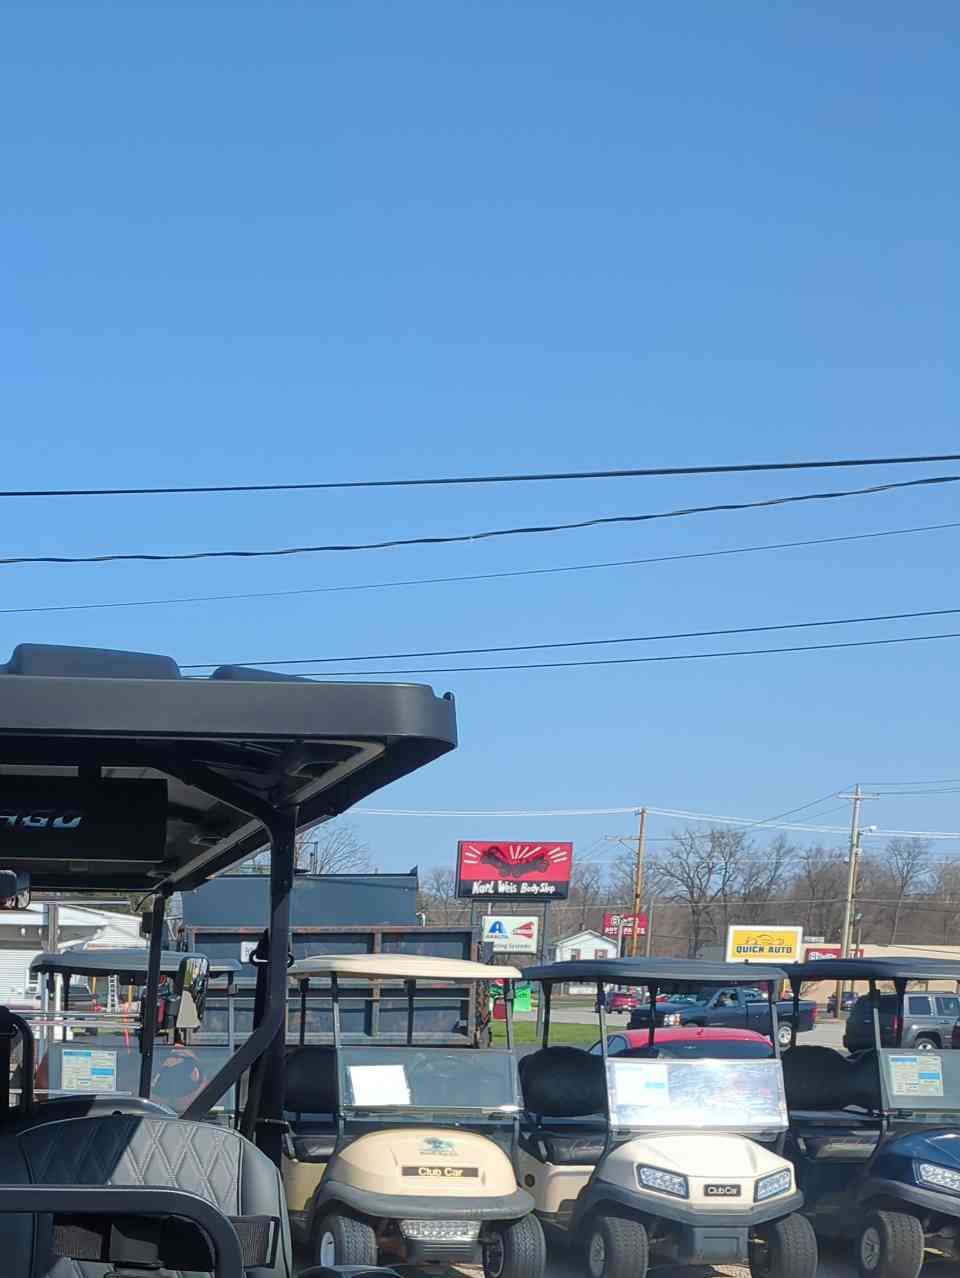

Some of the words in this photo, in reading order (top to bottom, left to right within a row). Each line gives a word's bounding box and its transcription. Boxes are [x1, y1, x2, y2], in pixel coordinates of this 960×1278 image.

[736, 945, 764, 954] QUICK
[768, 945, 792, 954] AUTO
[418, 1167, 442, 1177] Club
[444, 1168, 464, 1177] Car
